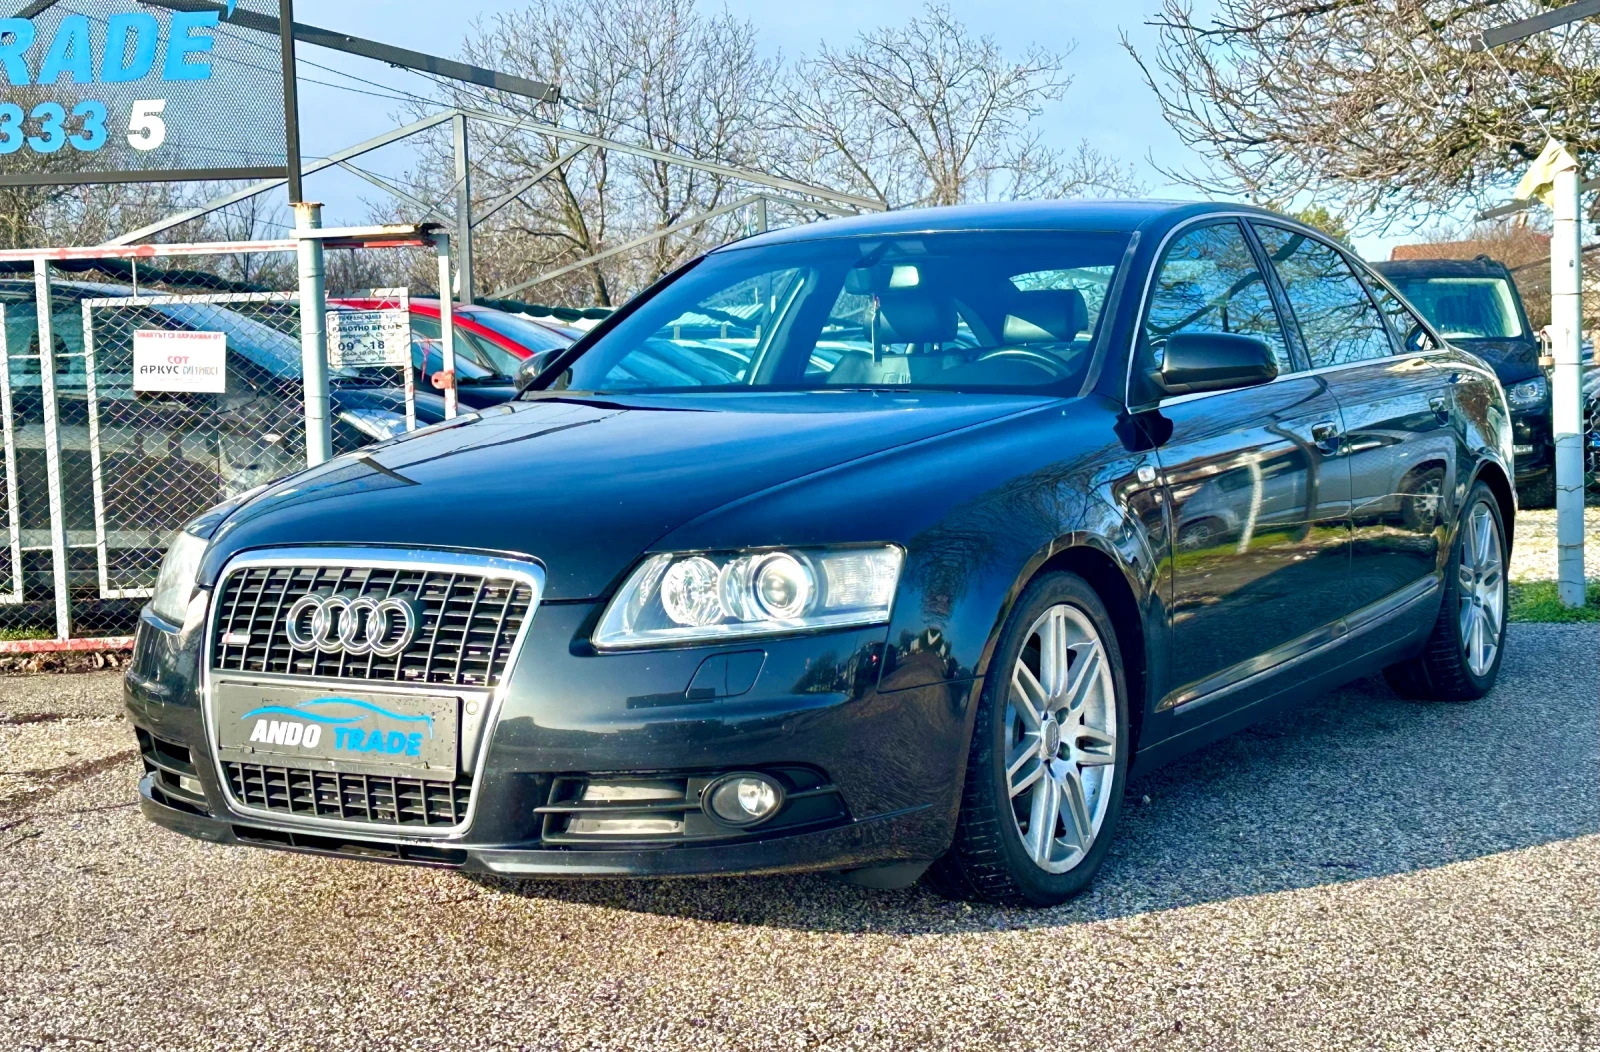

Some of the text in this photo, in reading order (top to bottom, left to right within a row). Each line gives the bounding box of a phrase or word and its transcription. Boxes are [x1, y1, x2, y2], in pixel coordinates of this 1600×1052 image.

[127, 99, 166, 151] 5
[140, 365, 179, 375] АРКУС
[167, 355, 189, 365] СОТ
[249, 718, 423, 756] ANDO TRADE
